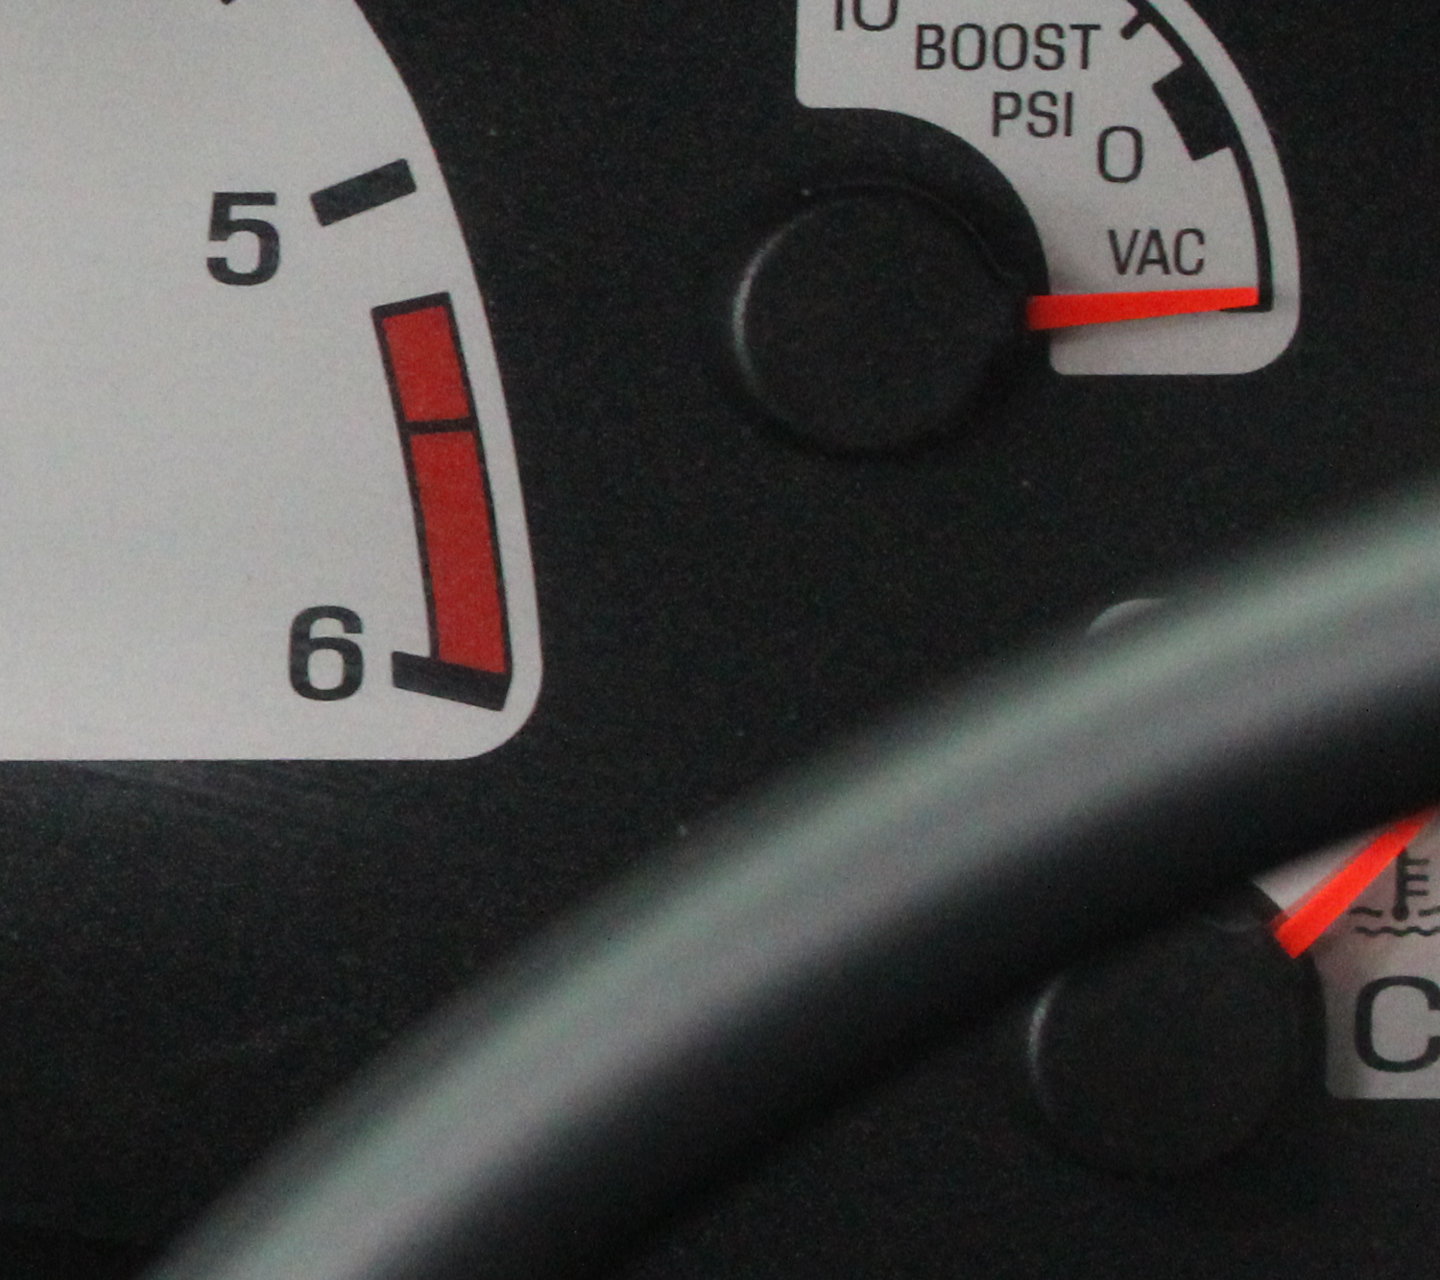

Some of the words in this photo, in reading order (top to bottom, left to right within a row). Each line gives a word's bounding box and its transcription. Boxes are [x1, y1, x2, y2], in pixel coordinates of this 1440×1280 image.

[916, 23, 1101, 71] BOOST
[993, 91, 1073, 138] PSI
[1097, 126, 1143, 183] 0
[207, 192, 280, 286] 5
[1108, 228, 1205, 276] VAC
[289, 606, 364, 701] 6
[1354, 975, 1440, 1072] C
